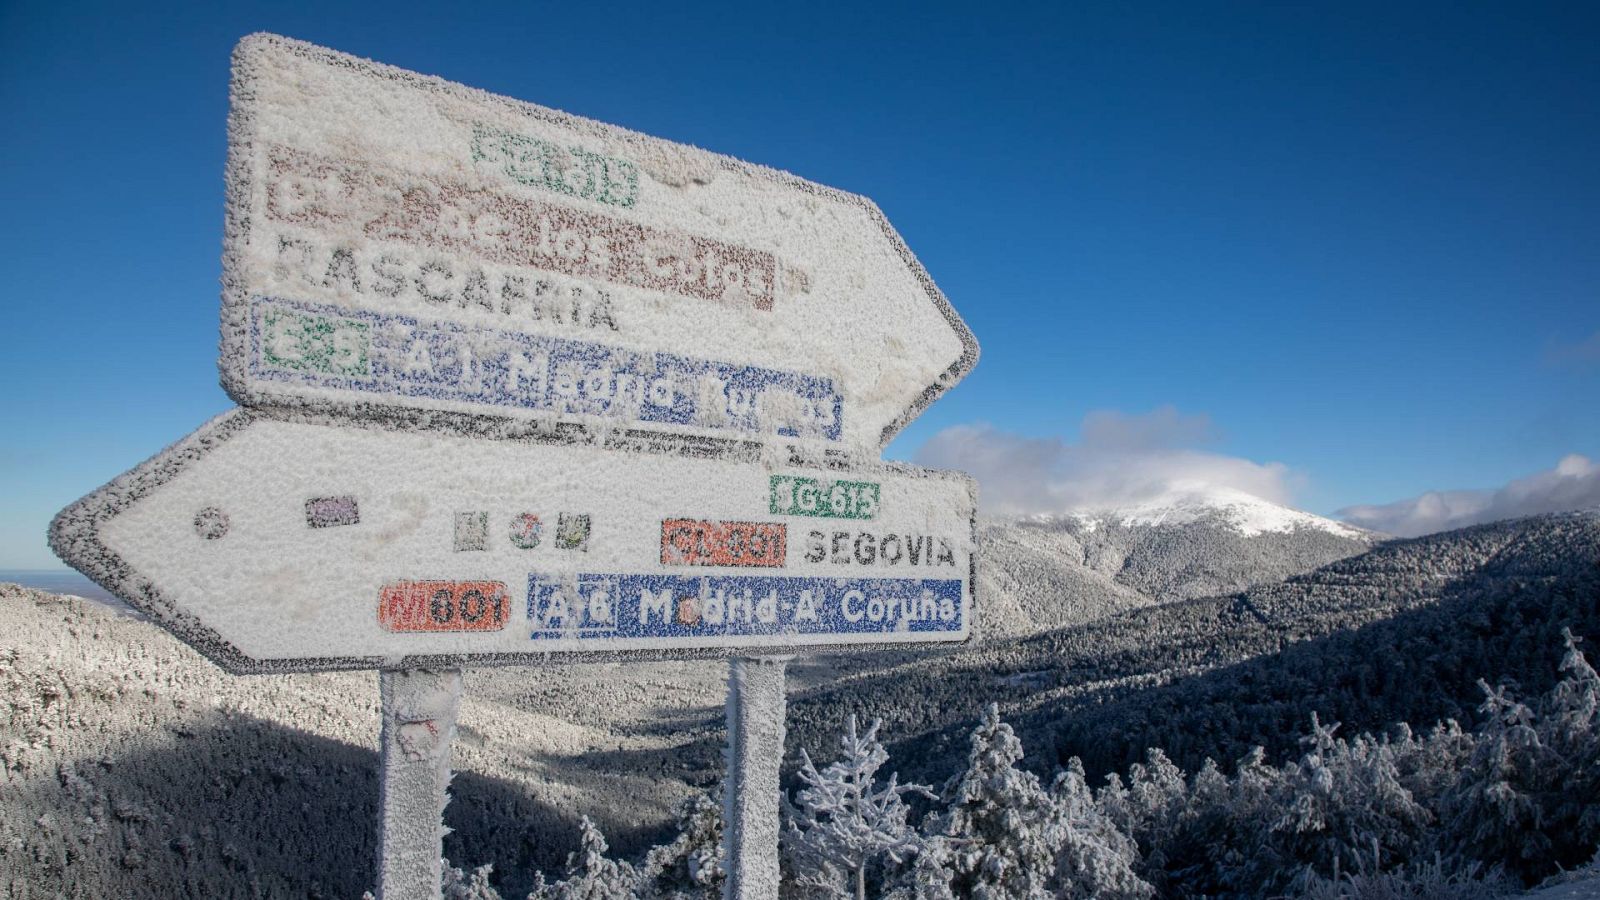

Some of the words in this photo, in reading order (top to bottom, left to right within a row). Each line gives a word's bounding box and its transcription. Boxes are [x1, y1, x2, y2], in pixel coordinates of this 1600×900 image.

[539, 218, 610, 265] los
[775, 478, 879, 515] G-615
[803, 530, 955, 567] SEGOVIA
[841, 588, 955, 623] Coruña
